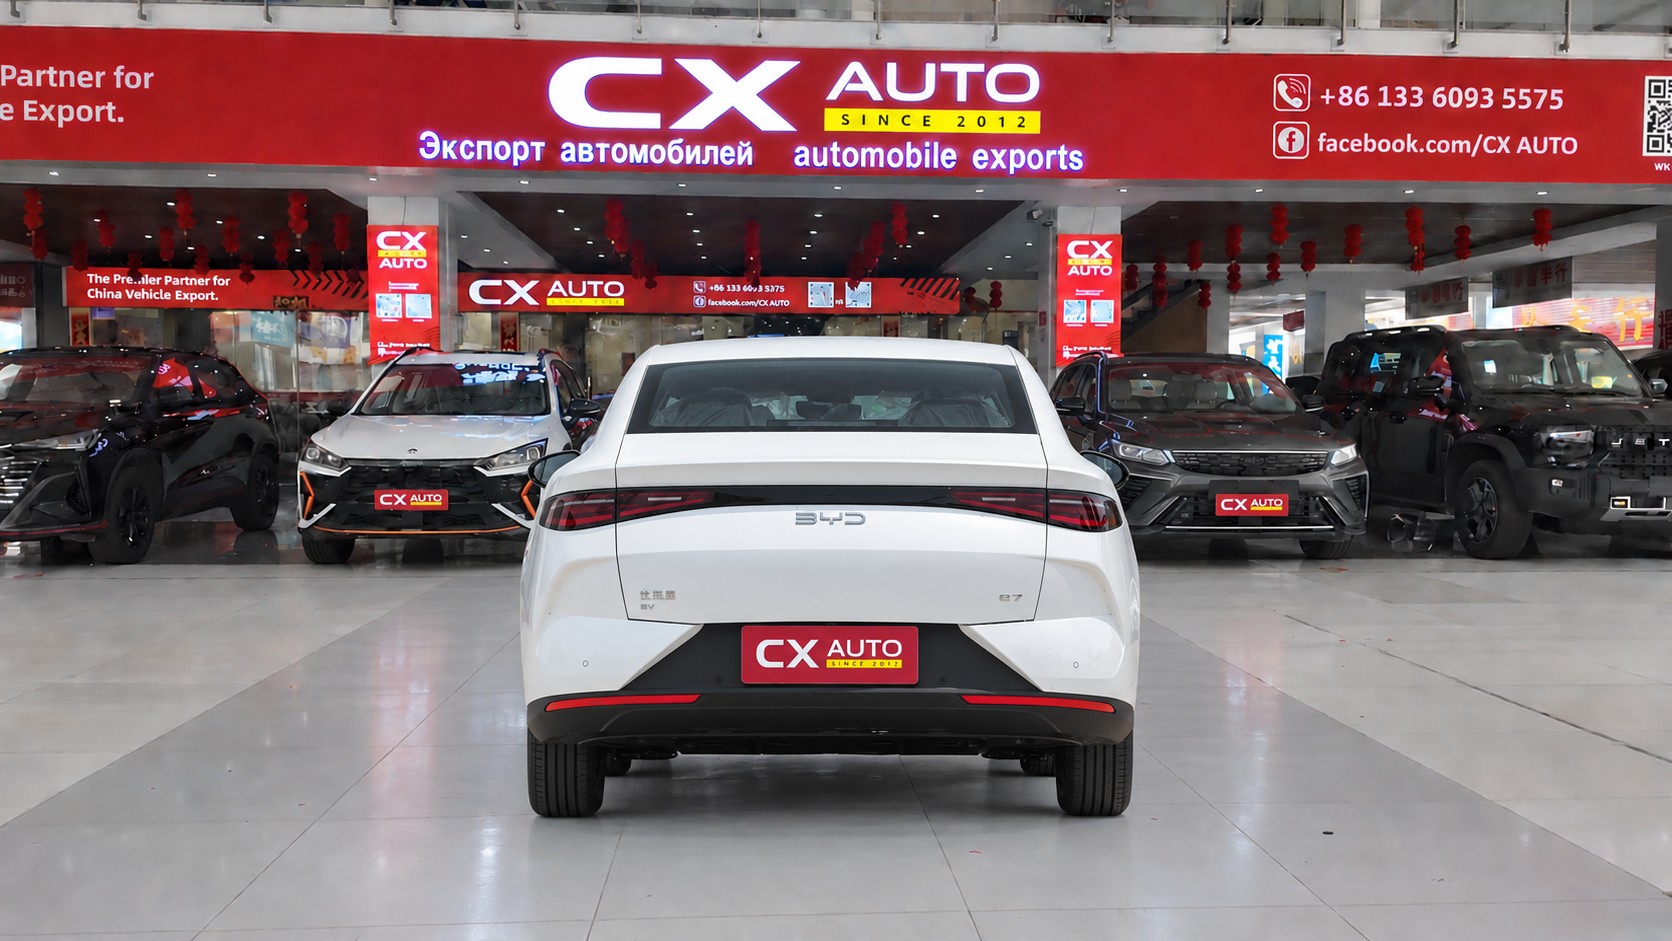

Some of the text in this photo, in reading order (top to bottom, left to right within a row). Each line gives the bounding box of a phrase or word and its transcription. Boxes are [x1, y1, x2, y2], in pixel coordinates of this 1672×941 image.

[0, 64, 154, 89] Partner for
[548, 56, 1041, 132] CX AUTO
[1320, 86, 1564, 110] +86 133 6093 5575
[23, 100, 124, 128] Export.
[841, 114, 1027, 129] SINCE 2012
[418, 130, 754, 167] Экспорт автомобилей
[1317, 133, 1579, 157] facebook.com/CX AUTO
[794, 141, 1084, 175] automobile exports
[376, 230, 427, 250] CX
[1066, 240, 1113, 259] CX
[378, 258, 428, 269] AUTO
[1067, 266, 1113, 276] AUTO
[87, 273, 110, 284] The
[164, 275, 210, 286] Partner
[213, 275, 230, 286] for
[726, 284, 741, 292] 133
[87, 288, 219, 303] China Vehicle Export.
[468, 279, 625, 306] CX AUTO
[769, 299, 790, 307] AUTO
[380, 494, 442, 506] CX AUTO
[1221, 499, 1283, 511] CX AUTO
[795, 512, 867, 526] BYD
[756, 639, 902, 669] CX AUTO
